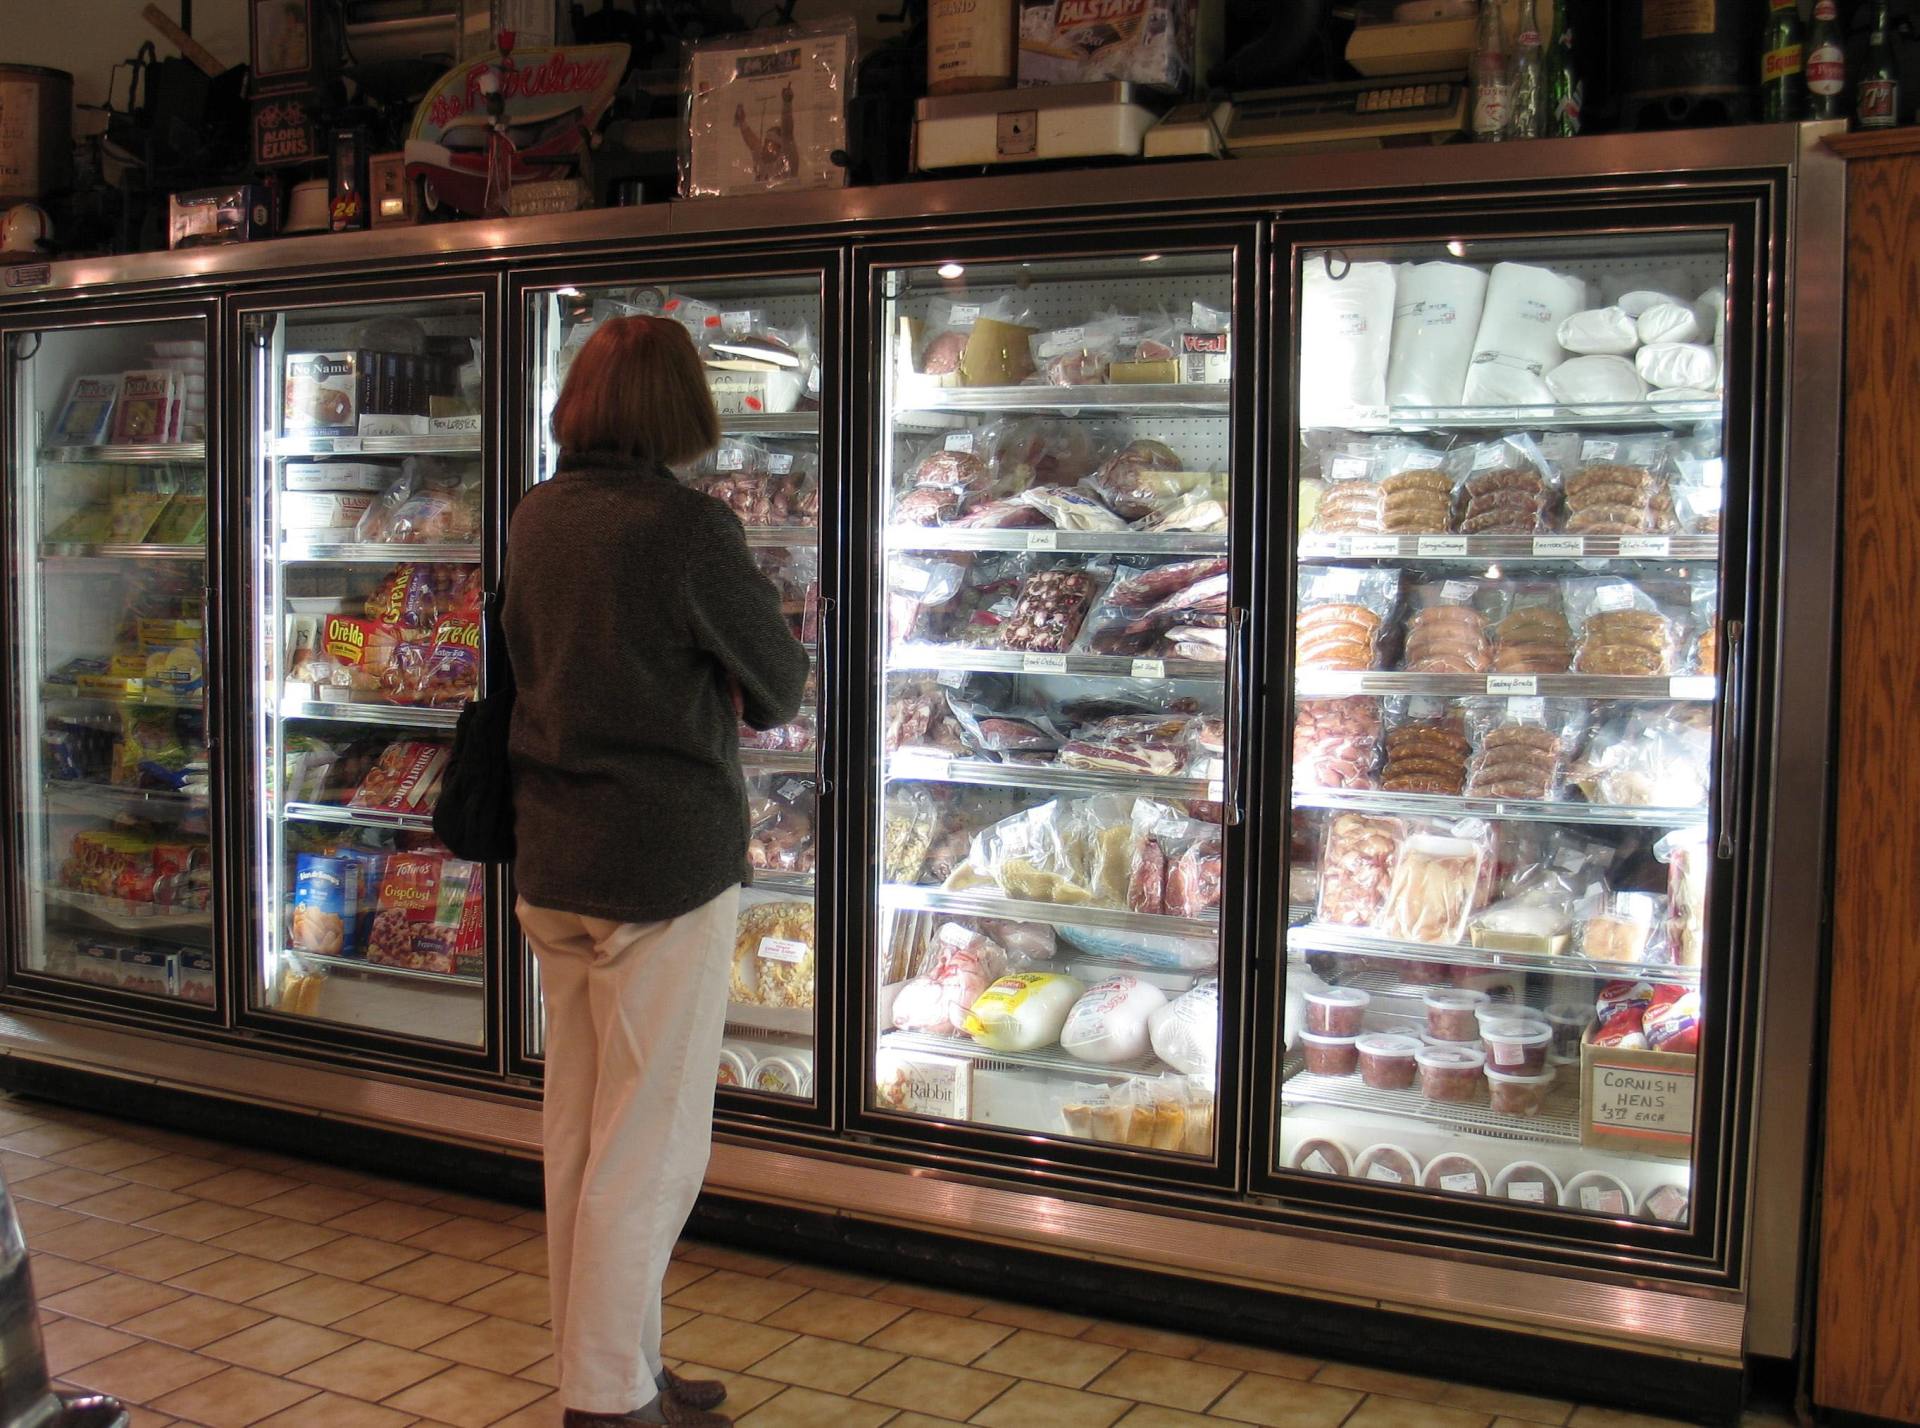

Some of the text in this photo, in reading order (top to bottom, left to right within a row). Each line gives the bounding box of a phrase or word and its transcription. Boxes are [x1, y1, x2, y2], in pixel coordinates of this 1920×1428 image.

[263, 127, 305, 143] ALOHA
[262, 139, 308, 159] ELVIS
[333, 202, 356, 217] 24
[1183, 335, 1226, 352] Veal
[313, 362, 349, 374] Name
[447, 418, 478, 430] LOBSTER
[388, 746, 436, 809] Smart Ones
[396, 862, 433, 877] Totino's
[1603, 1071, 1676, 1093] CORNISH
[910, 1080, 953, 1102] Rabbit
[1617, 1093, 1665, 1108] HENS
[1634, 1111, 1665, 1122] EACH
